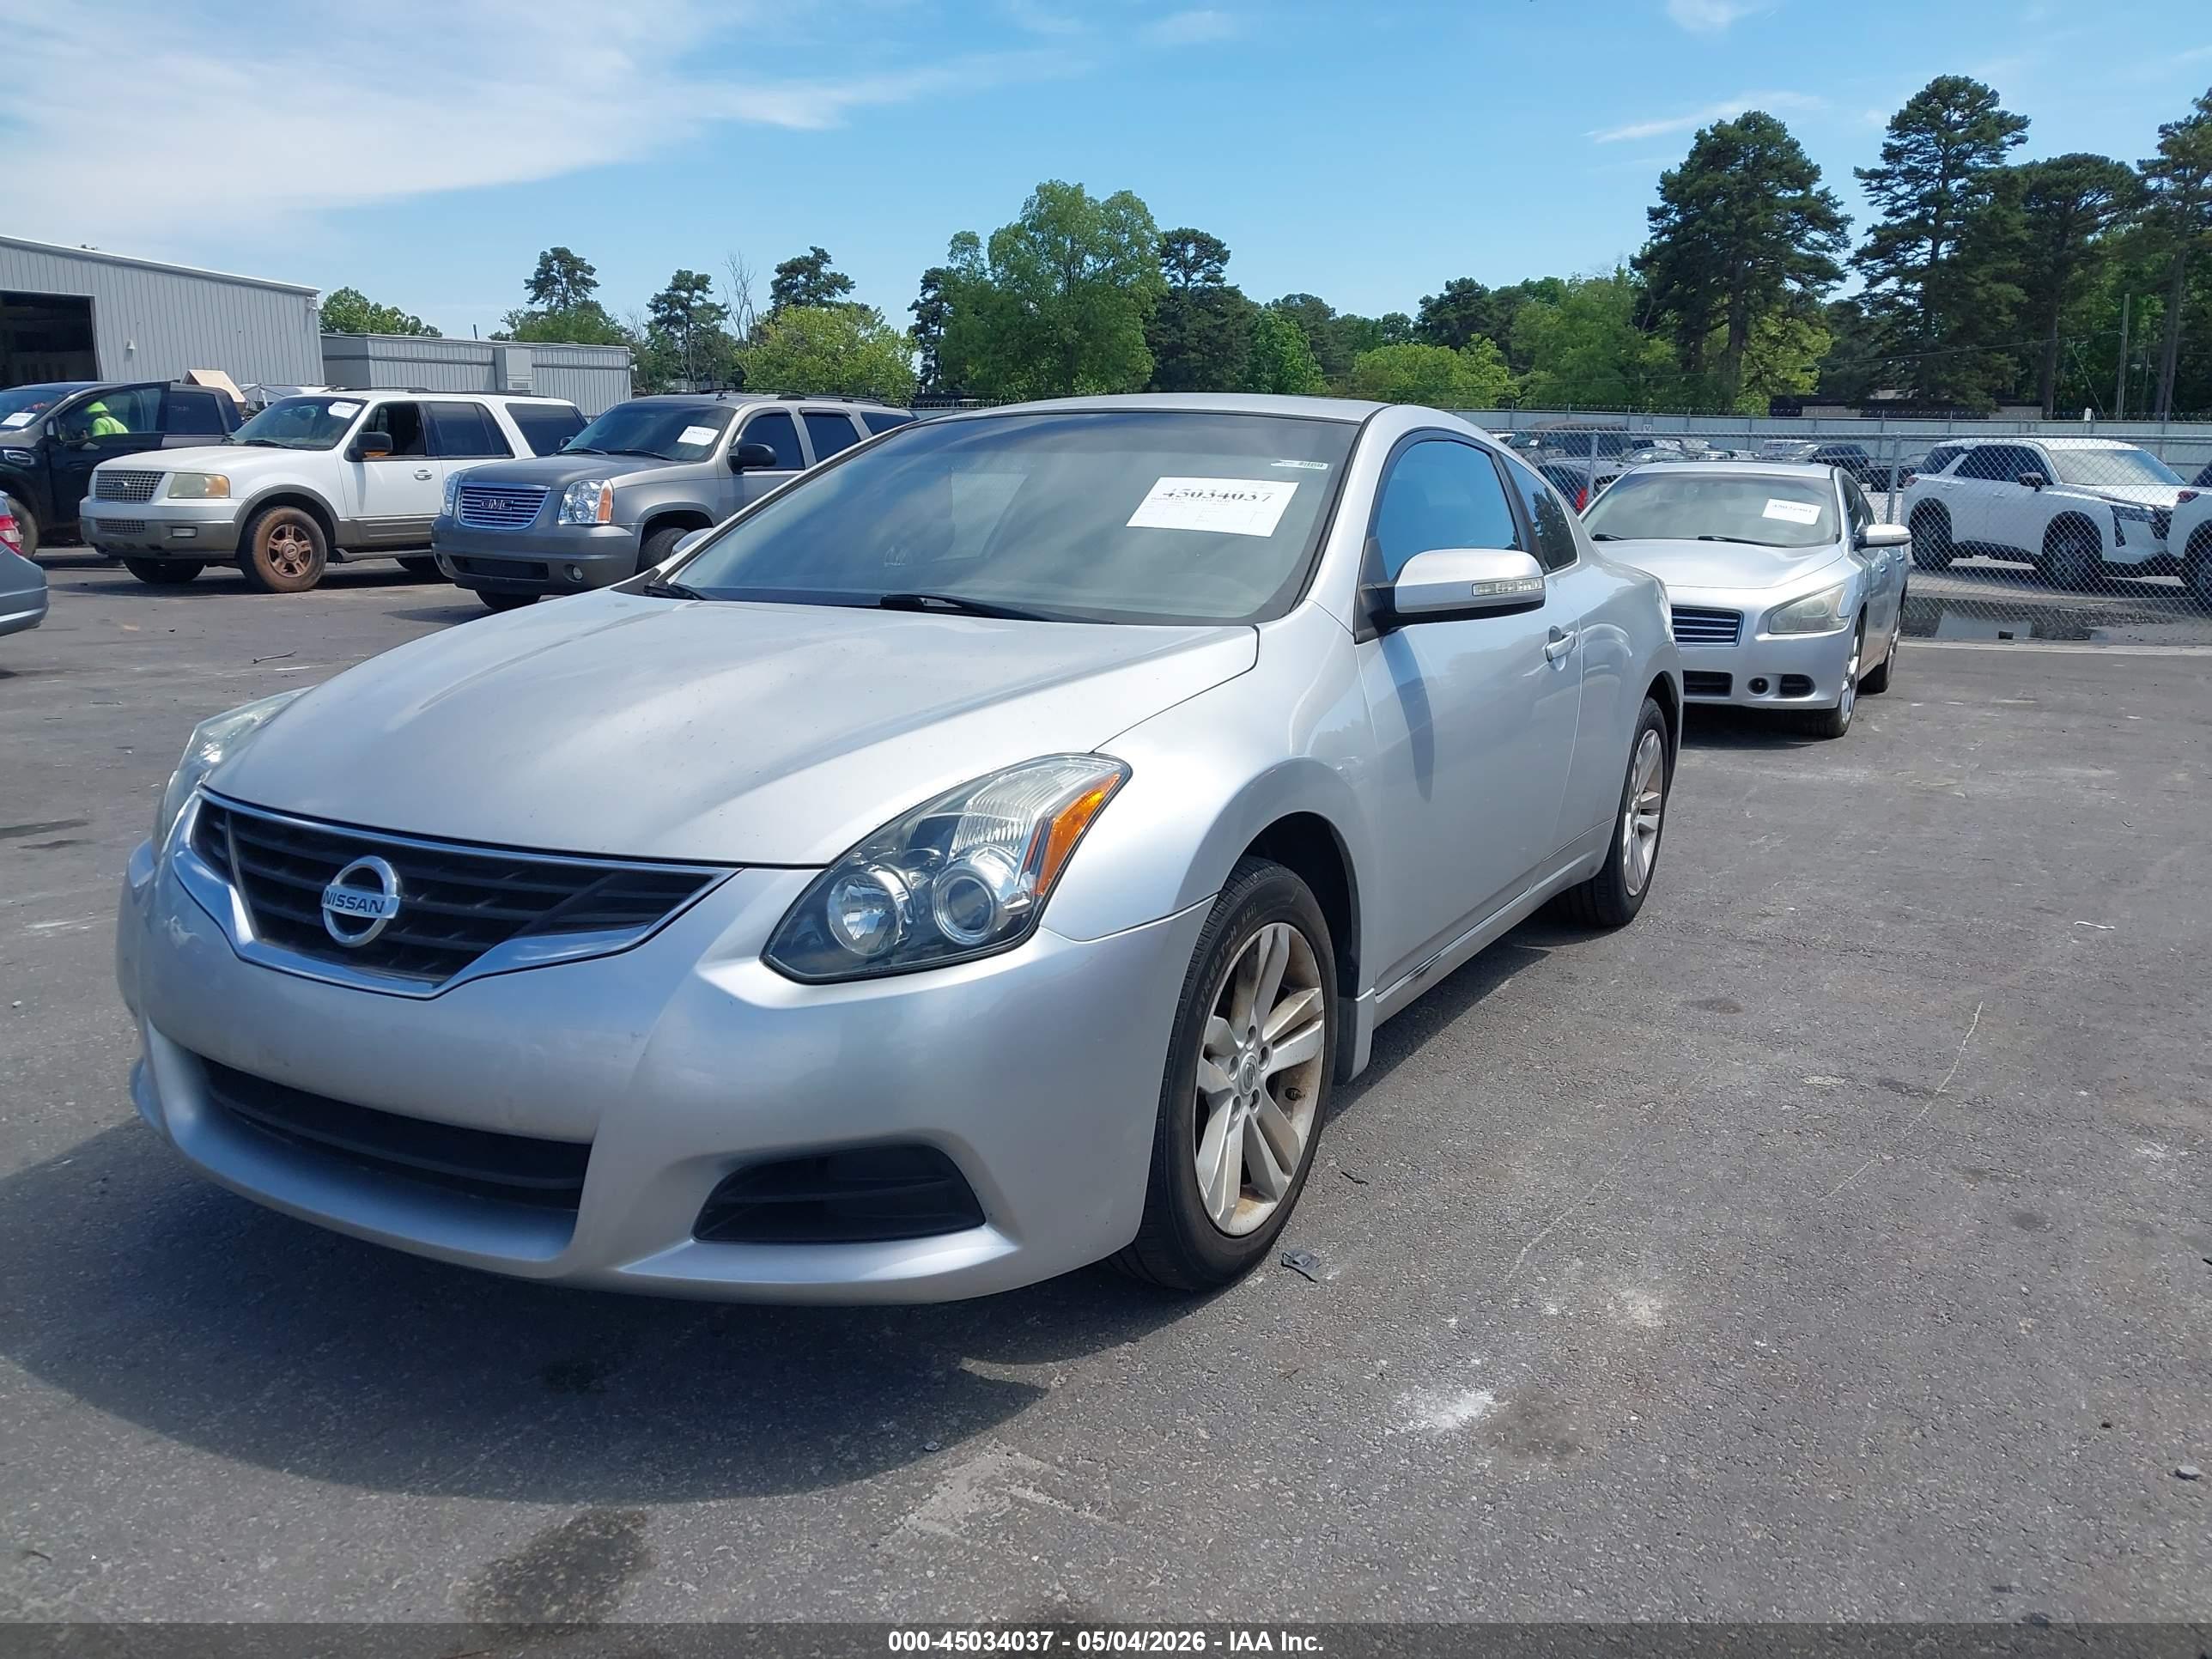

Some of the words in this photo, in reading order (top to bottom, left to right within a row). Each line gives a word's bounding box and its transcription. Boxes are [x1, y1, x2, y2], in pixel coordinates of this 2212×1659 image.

[1162, 488, 1275, 502] 45034037
[480, 498, 514, 512] GMC
[323, 890, 385, 914] NISSAN
